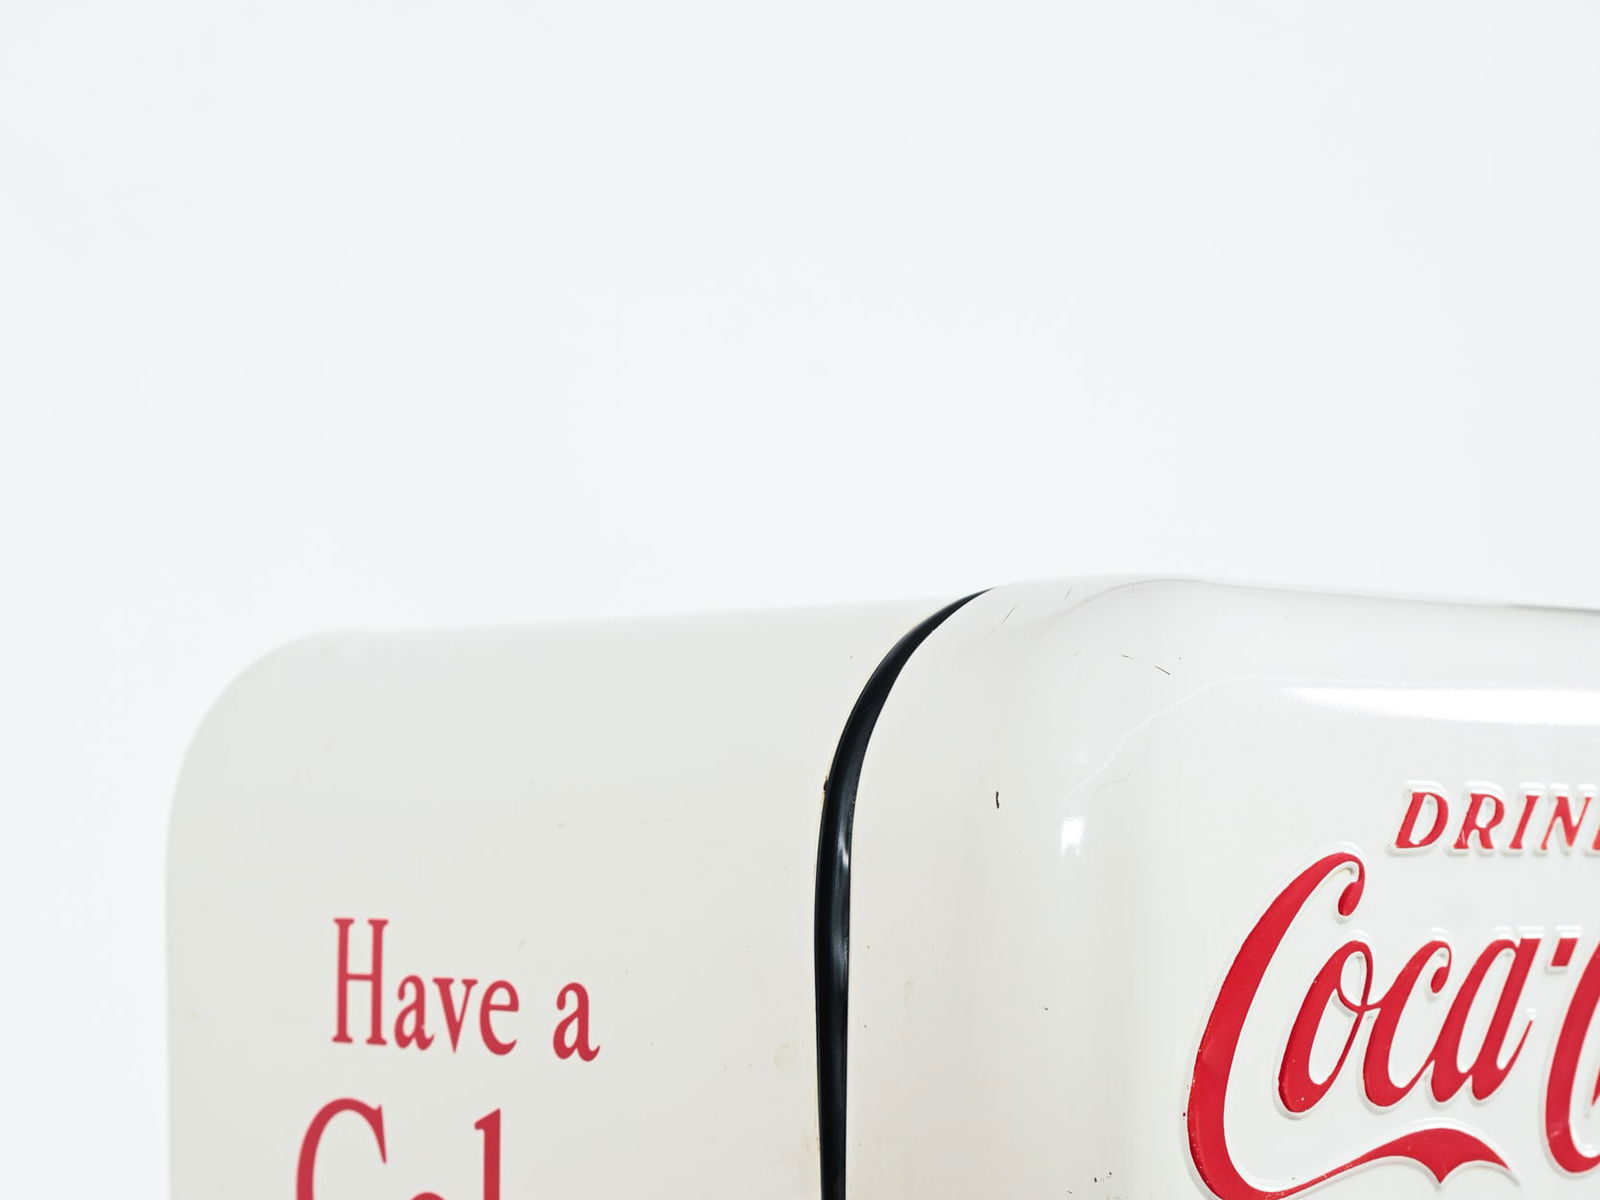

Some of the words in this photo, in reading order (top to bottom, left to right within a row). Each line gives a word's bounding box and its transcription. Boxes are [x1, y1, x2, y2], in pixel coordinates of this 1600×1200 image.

[1394, 790, 1600, 851] DRIN
[332, 917, 520, 1056] Have
[552, 982, 600, 1062] a
